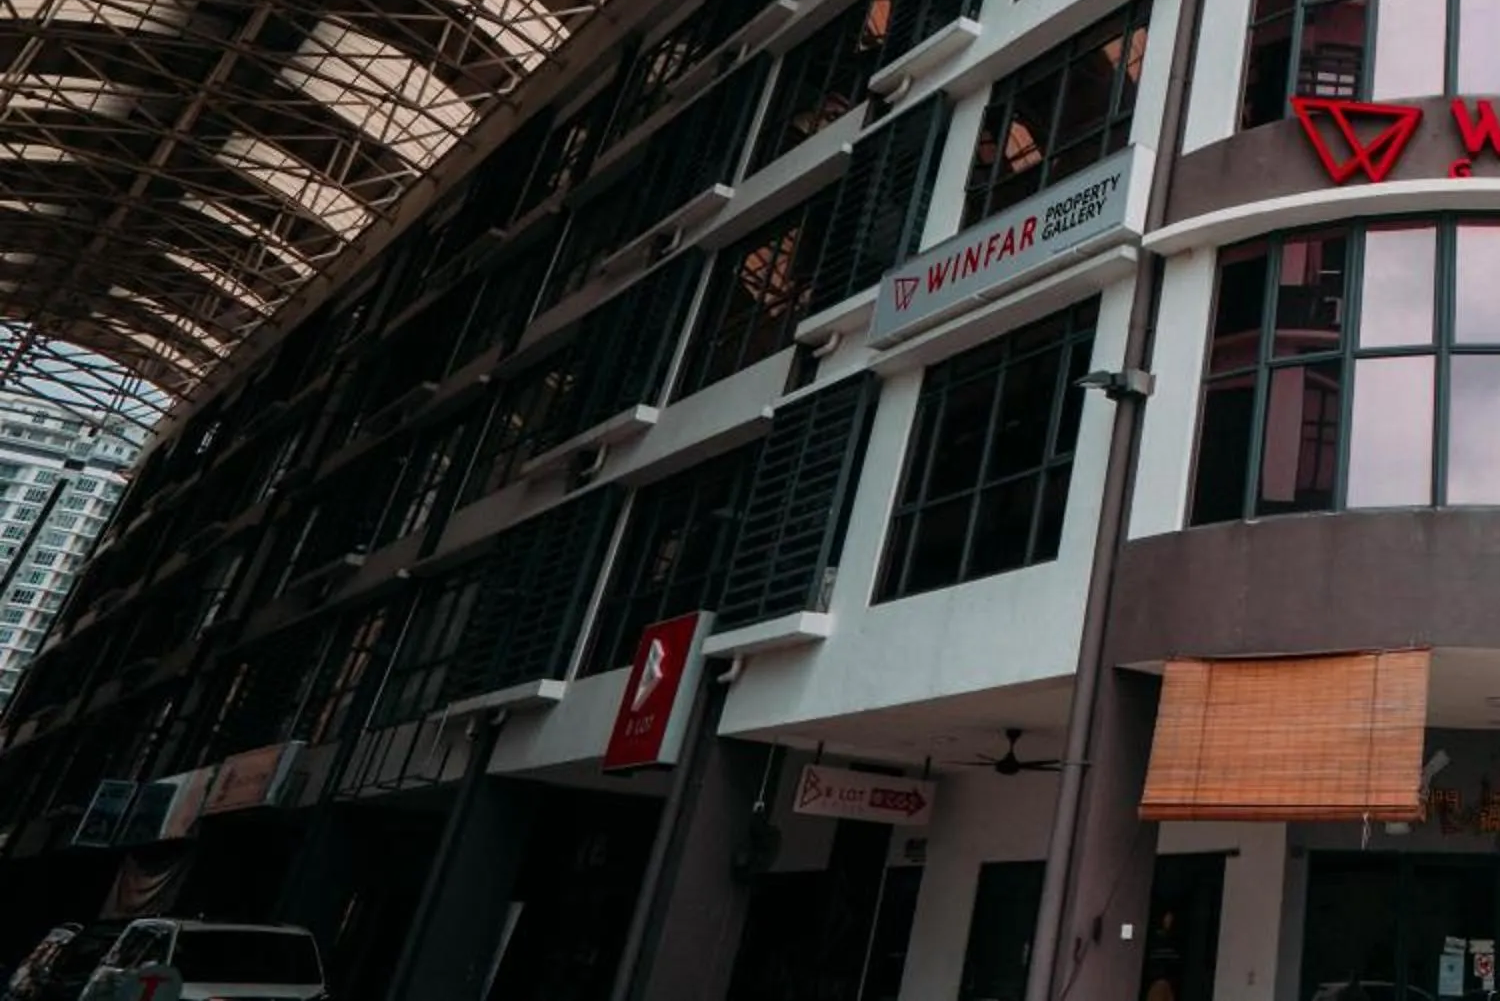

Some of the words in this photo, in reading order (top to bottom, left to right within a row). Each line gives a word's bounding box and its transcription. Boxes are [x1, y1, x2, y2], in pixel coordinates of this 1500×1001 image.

[927, 215, 1038, 293] WINFAR
[1045, 173, 1121, 223] PROPERTY
[1041, 199, 1106, 240] GALLERY
